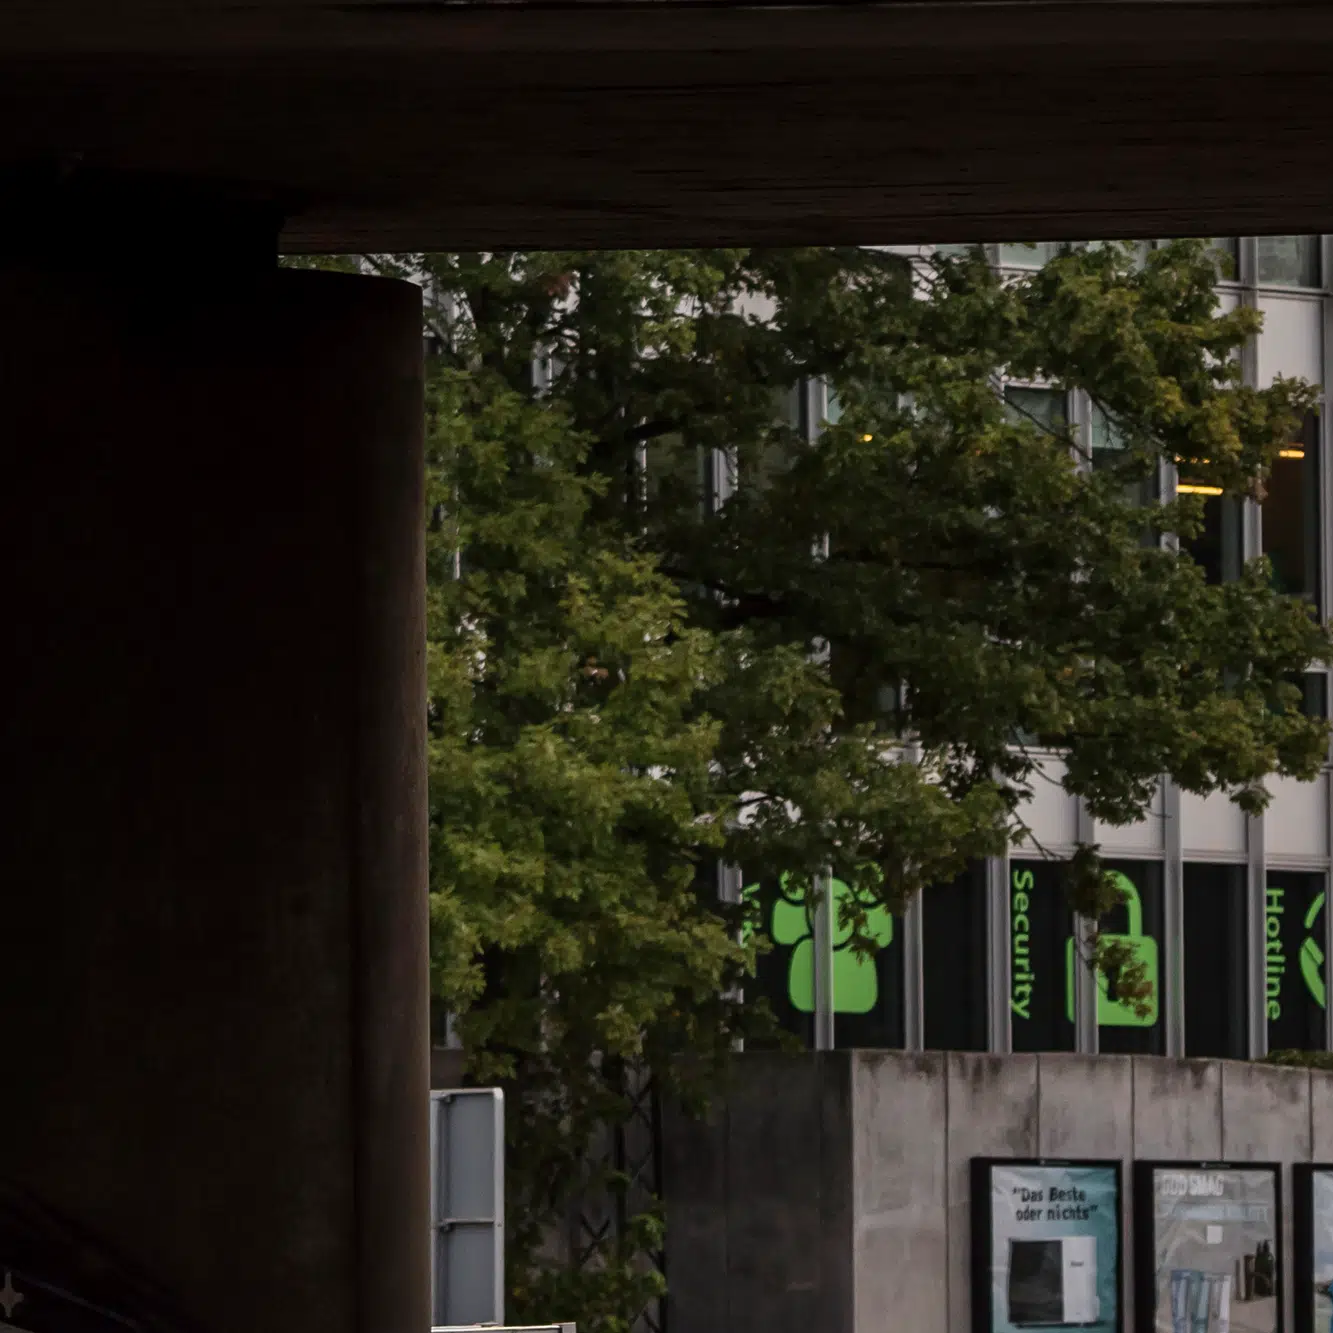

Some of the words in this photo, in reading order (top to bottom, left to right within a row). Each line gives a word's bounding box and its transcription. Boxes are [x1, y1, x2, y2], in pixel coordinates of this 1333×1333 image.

[1012, 869, 1035, 1020] Security
[1265, 888, 1285, 1020] Hotline
[1016, 1206, 1045, 1221] oder
[1049, 1186, 1086, 1202] Beste
